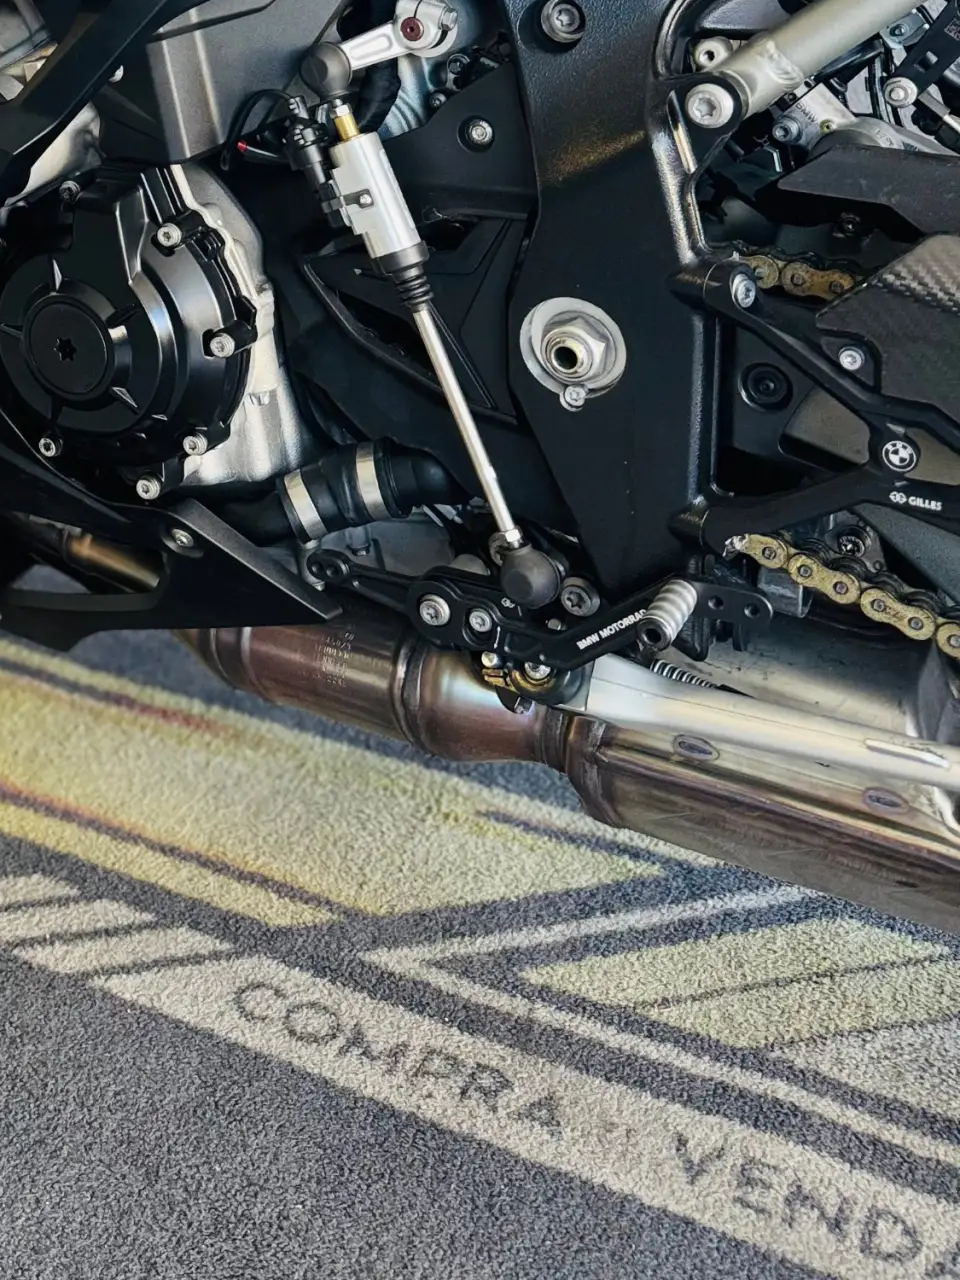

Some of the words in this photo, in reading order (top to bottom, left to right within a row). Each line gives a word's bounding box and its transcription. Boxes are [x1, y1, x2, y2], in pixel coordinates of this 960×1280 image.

[908, 496, 942, 511] GILLES
[576, 633, 600, 650] BMW
[235, 979, 563, 1139] COMPRA
